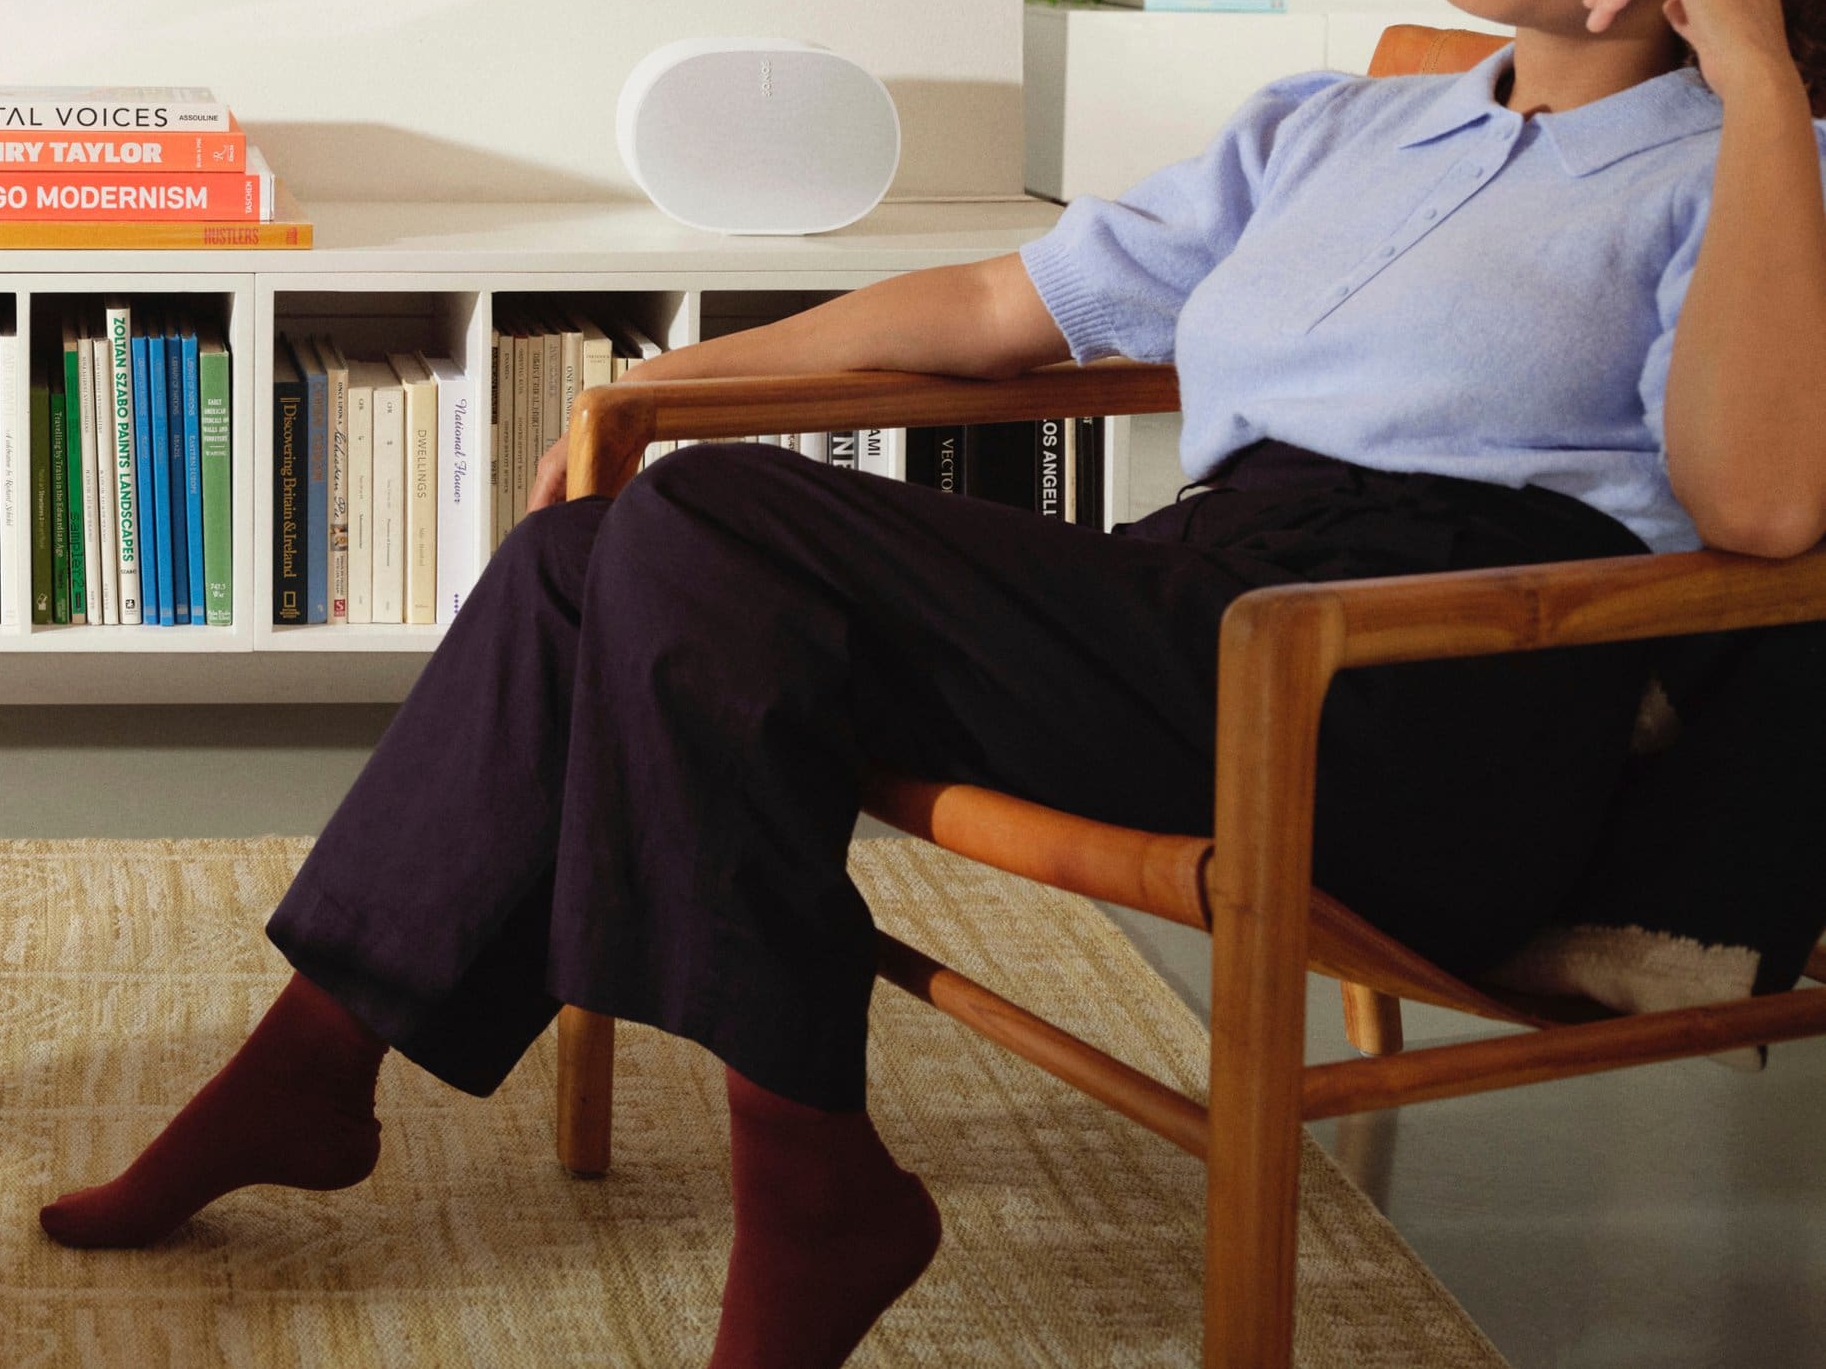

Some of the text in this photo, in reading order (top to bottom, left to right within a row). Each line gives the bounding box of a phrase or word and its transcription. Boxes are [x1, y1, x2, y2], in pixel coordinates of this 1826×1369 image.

[761, 59, 775, 97] SONOS
[56, 107, 168, 128] VOICES
[50, 141, 162, 164] TAYLOR
[36, 185, 208, 210] MODERNISM
[204, 228, 259, 245] HUSTLERS
[54, 412, 63, 449] Travelling
[114, 317, 134, 563] ZOLTAN SZABO PAINTS LANDSCAPES
[867, 428, 881, 457] AMI
[1043, 418, 1058, 447] OS
[417, 429, 427, 499] DWELLINGS
[453, 398, 468, 504] National Flower
[941, 438, 955, 494] VECTO
[54, 460, 63, 481] Train
[283, 404, 297, 578] Discovering Britain & Ireland
